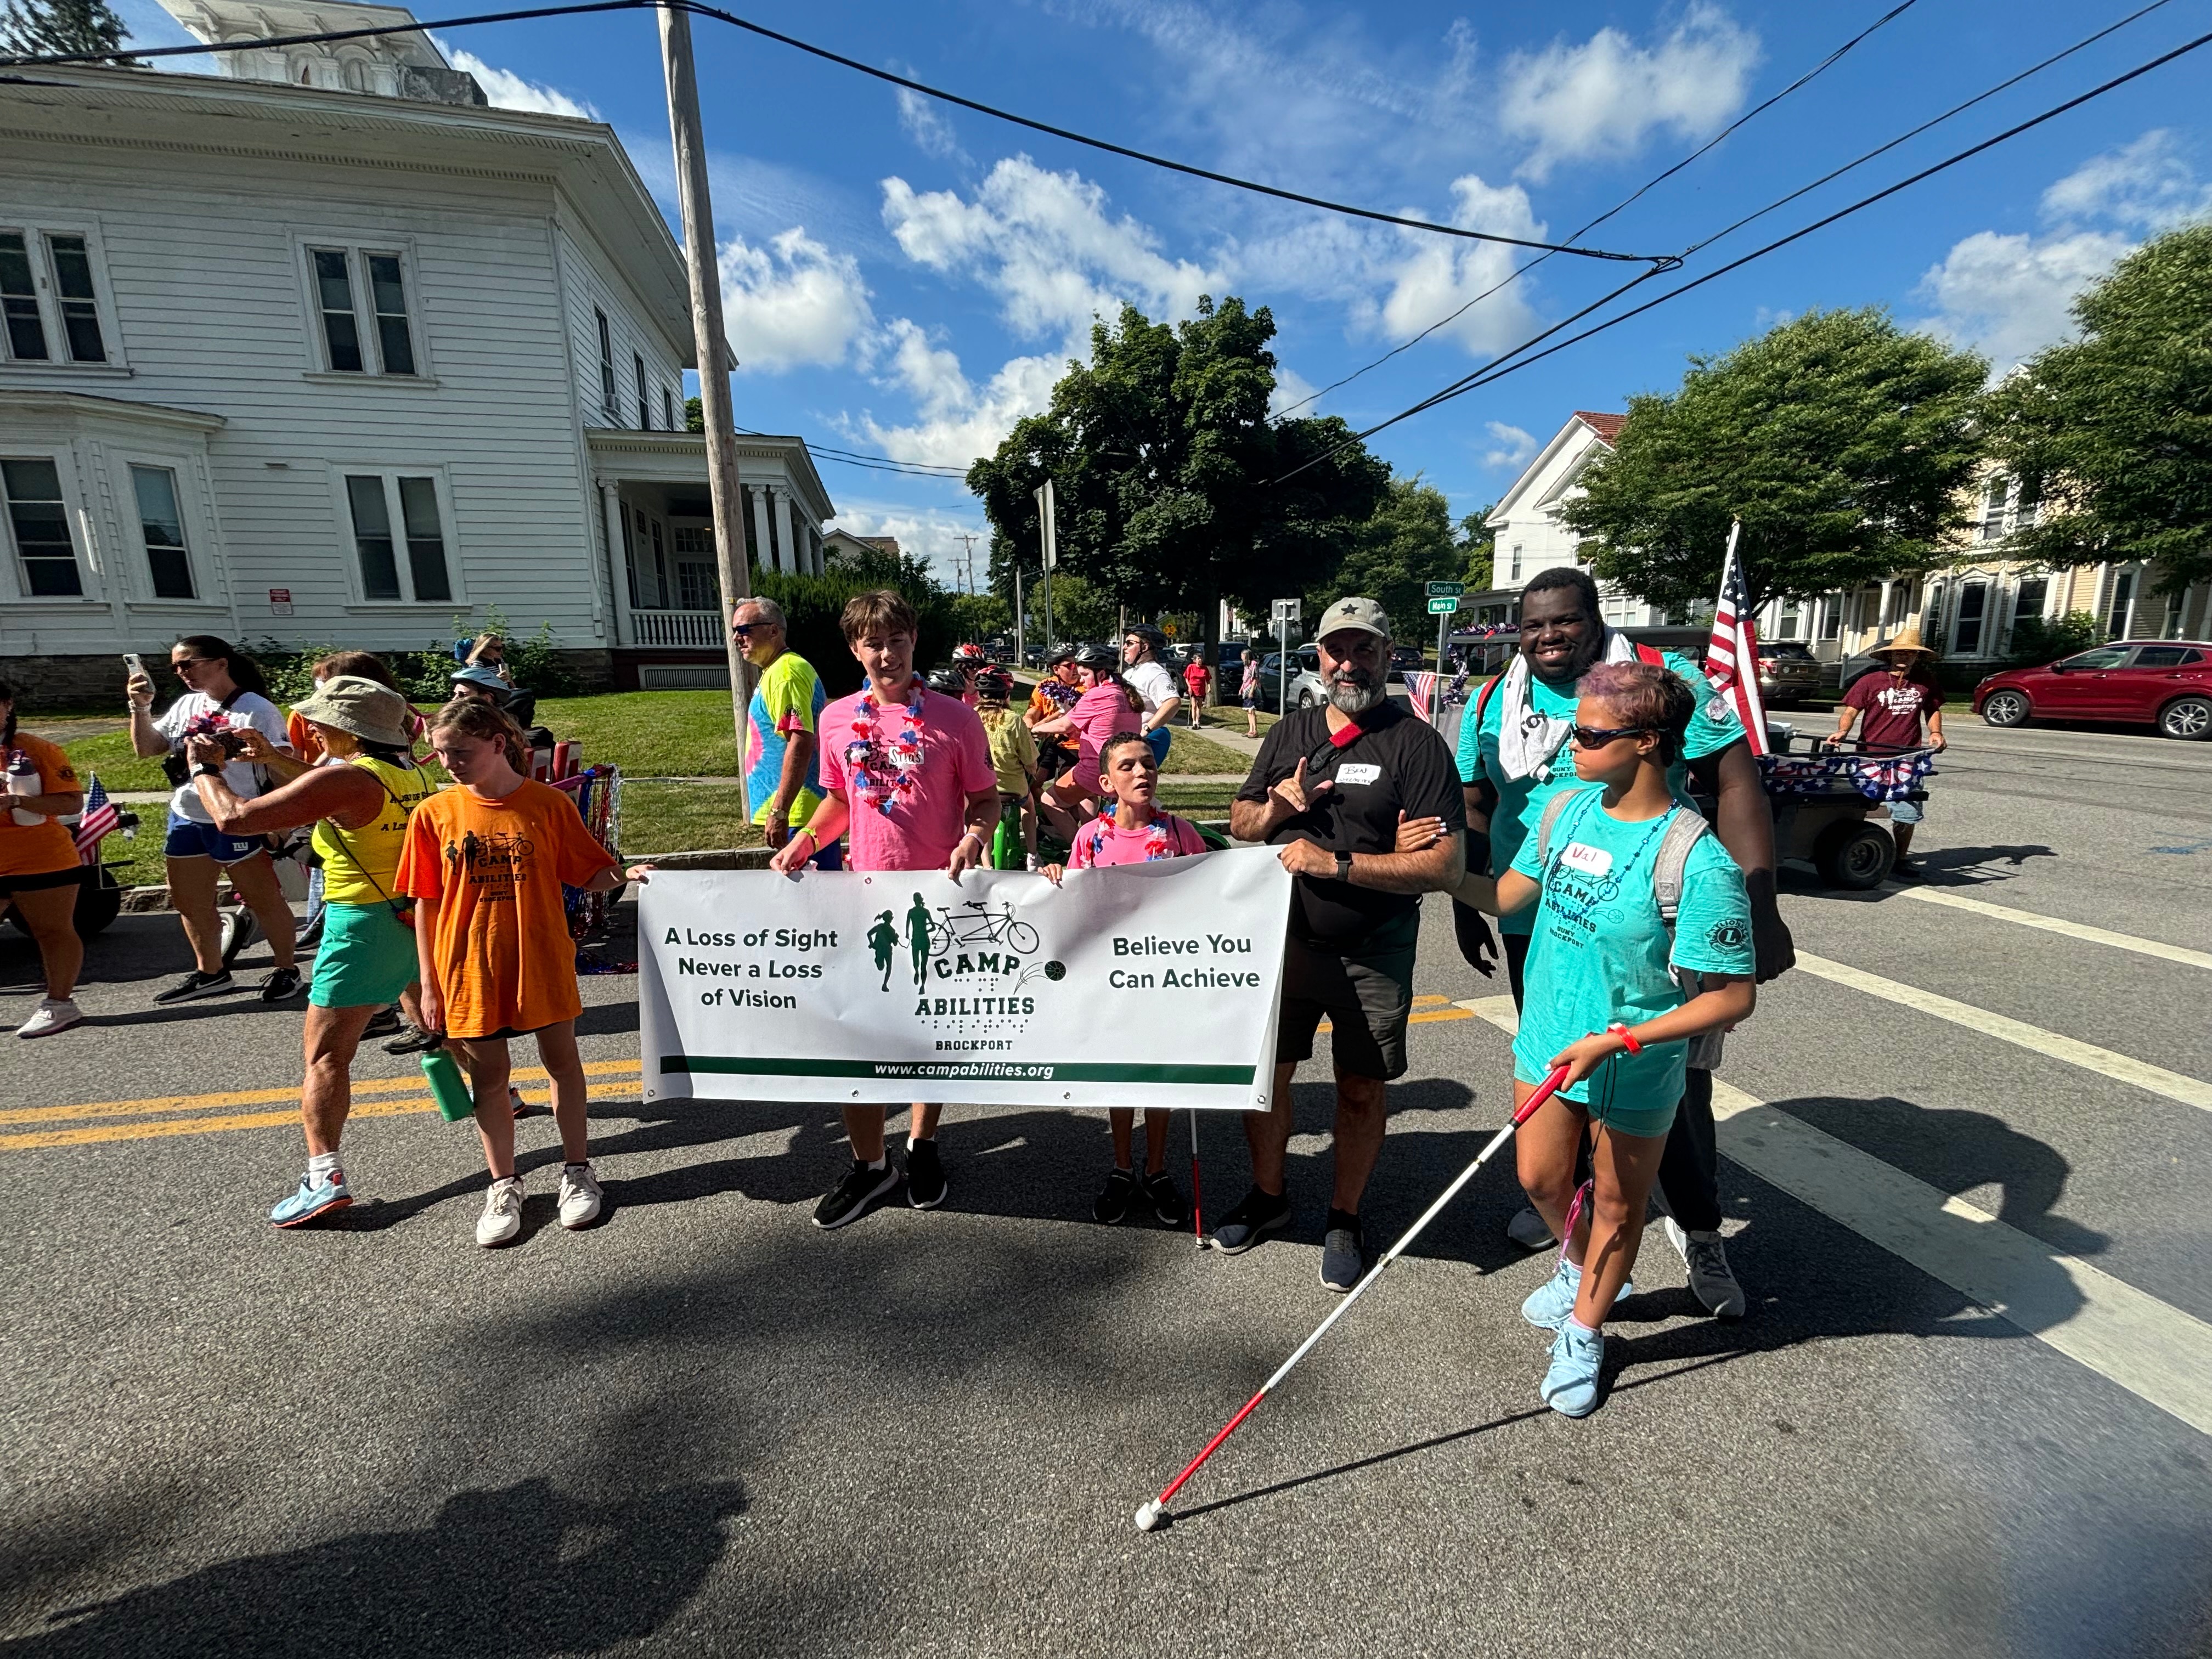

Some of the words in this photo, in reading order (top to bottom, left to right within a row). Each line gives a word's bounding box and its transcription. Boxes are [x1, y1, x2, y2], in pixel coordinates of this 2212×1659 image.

[1431, 584, 1453, 594] South
[1432, 601, 1446, 611] Main
[478, 855, 522, 867] CAMP
[1572, 847, 1597, 862] Val
[1719, 920, 1744, 929] LIONS
[664, 927, 681, 945] A
[687, 928, 736, 947] Loss
[743, 929, 770, 947] of
[775, 929, 838, 952] Sight
[1113, 935, 1199, 956] Believe
[1206, 934, 1251, 953] You
[1724, 930, 1736, 943] L
[679, 957, 742, 977] Never
[748, 964, 760, 978] a
[769, 960, 822, 978] Loss
[934, 952, 1020, 979] CAMP
[1109, 969, 1154, 989] Can
[1162, 967, 1260, 988] Achieve
[701, 988, 724, 1006] of
[728, 989, 797, 1009] Vision
[915, 997, 1035, 1016] ABILITIES
[935, 1040, 1013, 1051] BROCKPORT
[874, 1063, 1054, 1080] www.campabilities.org
